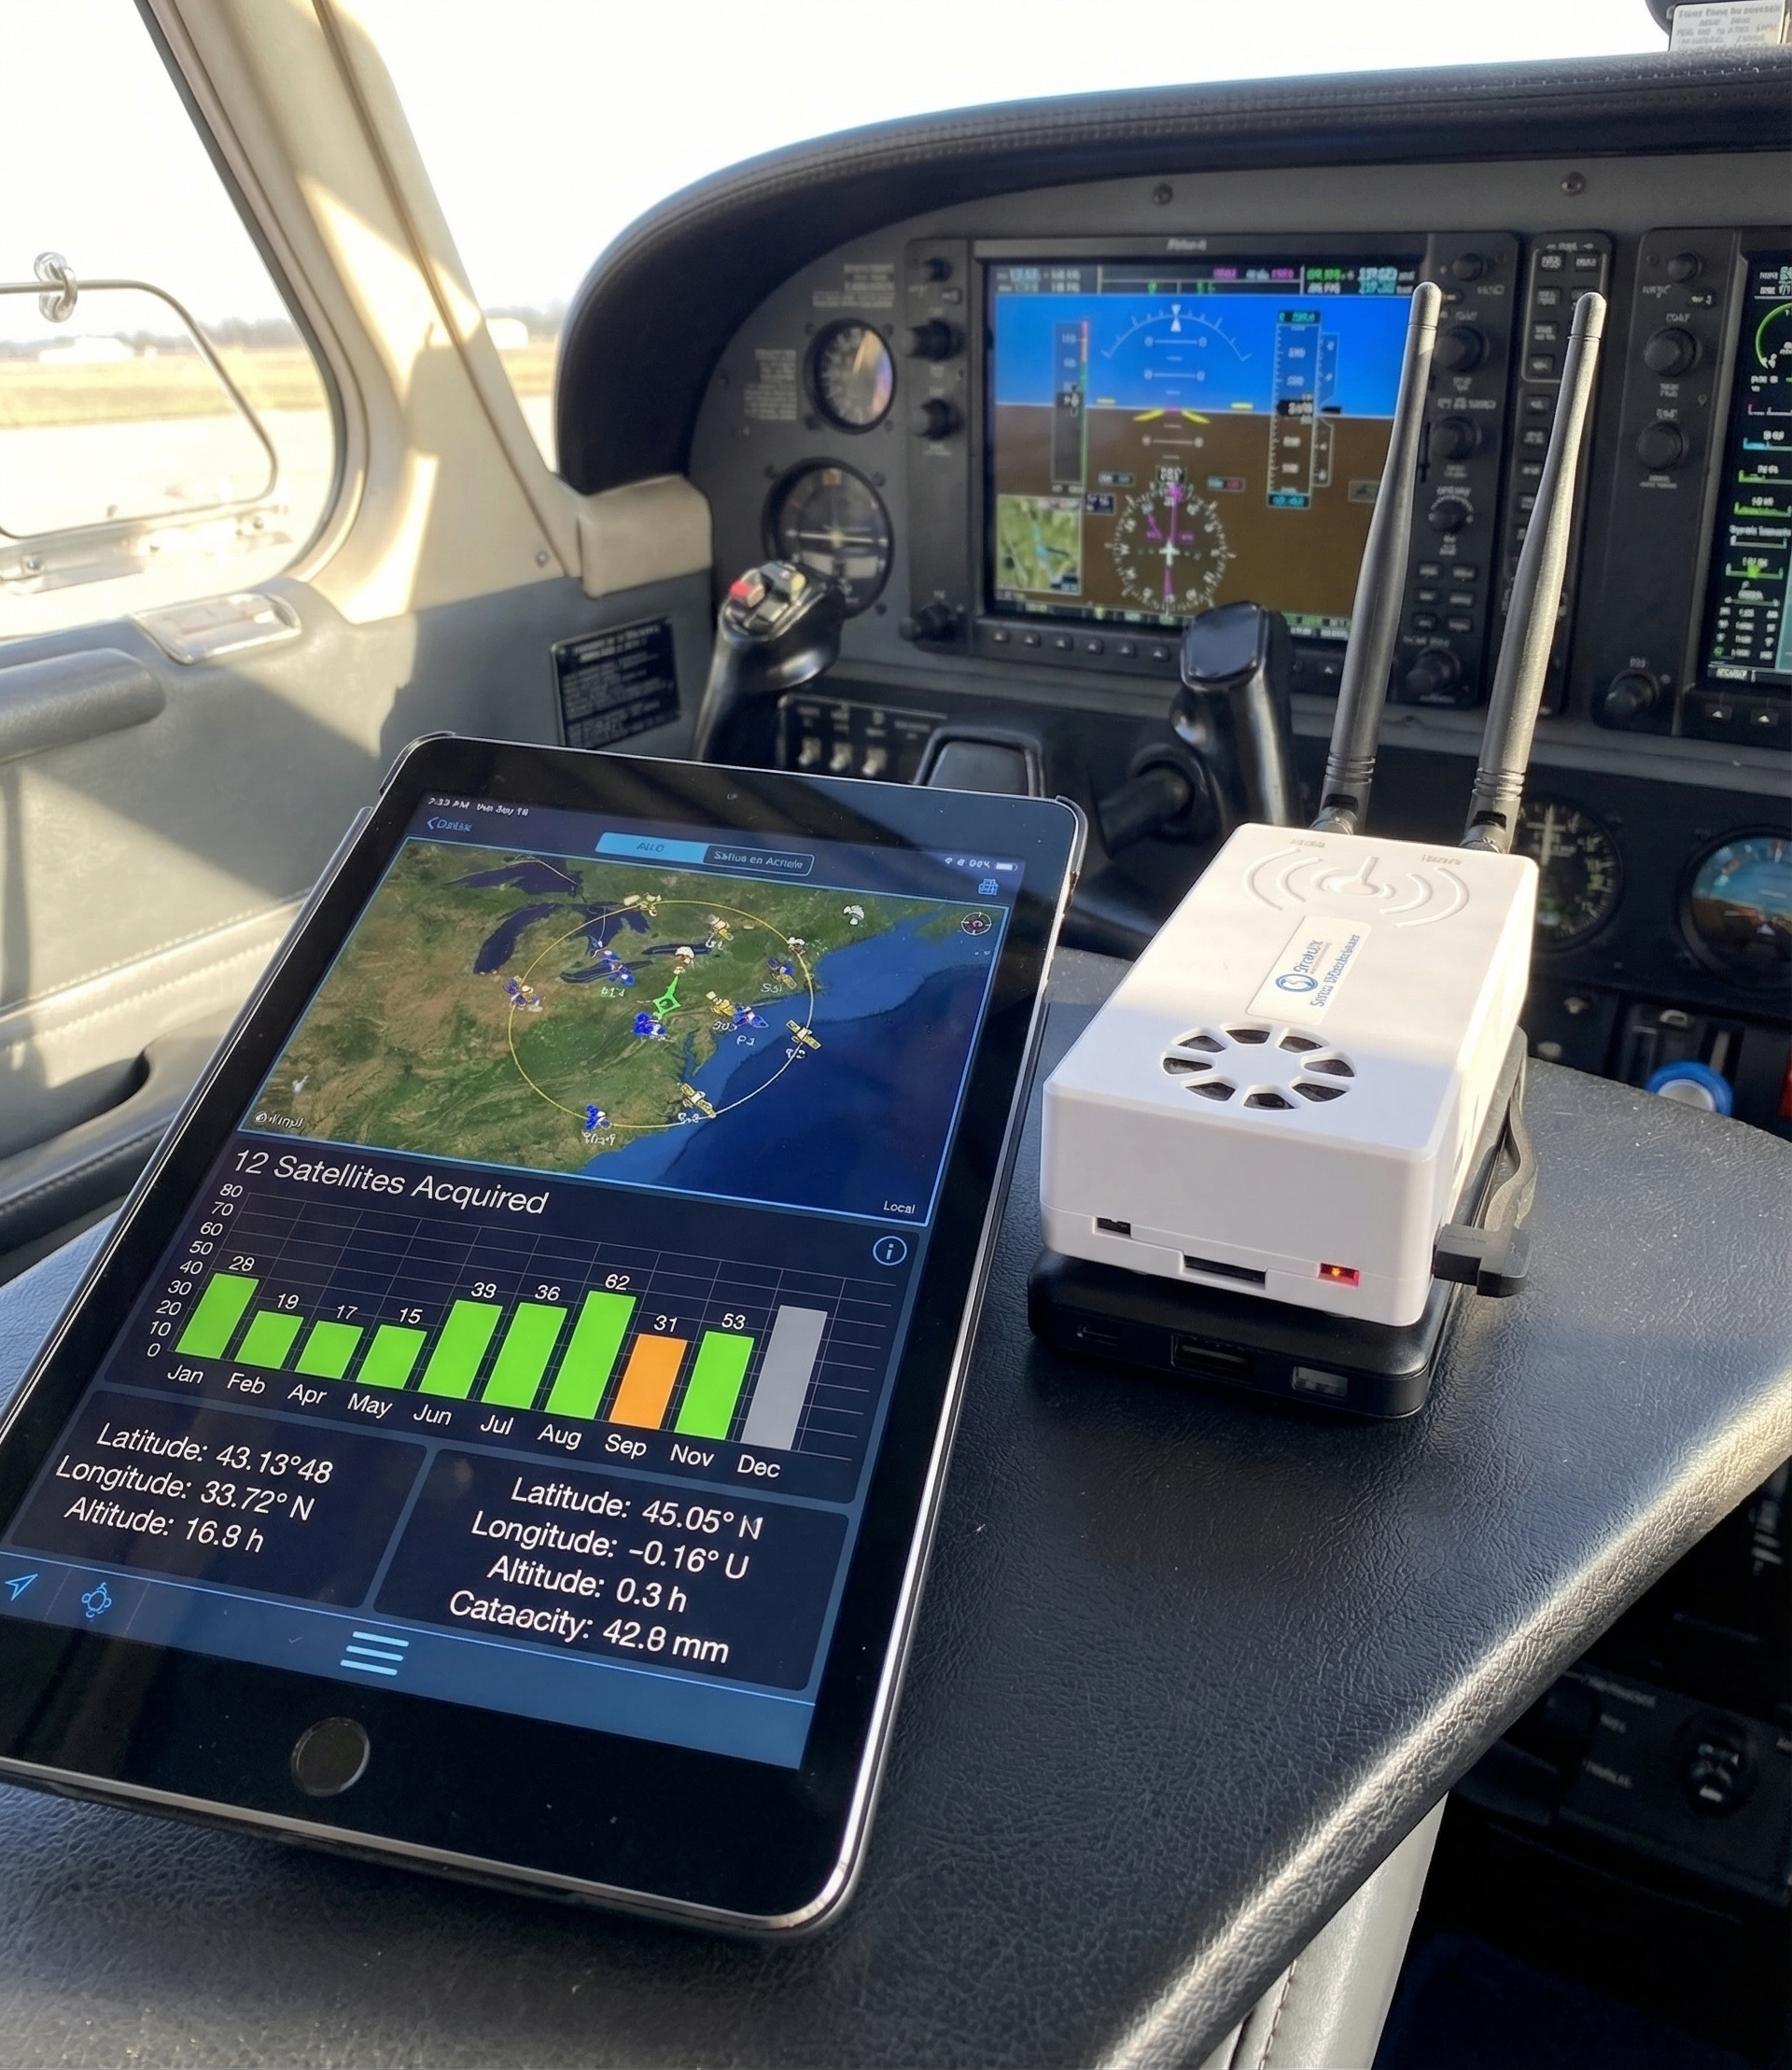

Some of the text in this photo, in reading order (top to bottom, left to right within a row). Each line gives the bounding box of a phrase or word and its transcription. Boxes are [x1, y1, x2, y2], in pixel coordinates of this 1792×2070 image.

[219, 1183, 243, 1197] 80
[234, 1149, 550, 1214] 12 Satellites Acquired
[211, 1201, 233, 1216] 70
[883, 1200, 916, 1214] Local
[200, 1222, 223, 1237] 60
[189, 1240, 214, 1255] 50
[179, 1261, 203, 1275] 40
[229, 1255, 256, 1272] 28
[167, 1280, 192, 1295] 30
[605, 1273, 630, 1291] 62
[276, 1293, 300, 1309] 19
[534, 1284, 560, 1301] 36
[156, 1299, 182, 1316] 20
[336, 1305, 358, 1321] 17
[399, 1308, 423, 1325] 15
[653, 1315, 678, 1333] 31
[721, 1312, 746, 1330] 53
[149, 1321, 171, 1336] 10
[147, 1342, 161, 1358] 0
[167, 1364, 780, 1479] Jan Feb Apr May Jun Jul Aug Sep Nov Dec
[96, 1422, 333, 1484] Latitude: 43.13°48
[55, 1454, 315, 1521] Longitude: 33.72° N
[511, 1476, 763, 1540] Latitude: 45.05° N
[63, 1496, 175, 1536] Altitude:
[245, 1528, 264, 1553] h
[470, 1510, 618, 1559] Longitude:
[724, 1553, 749, 1579] U
[487, 1555, 688, 1613] Altitude: 0.3 h
[602, 1617, 667, 1652] 42.8
[672, 1634, 729, 1664] mm
